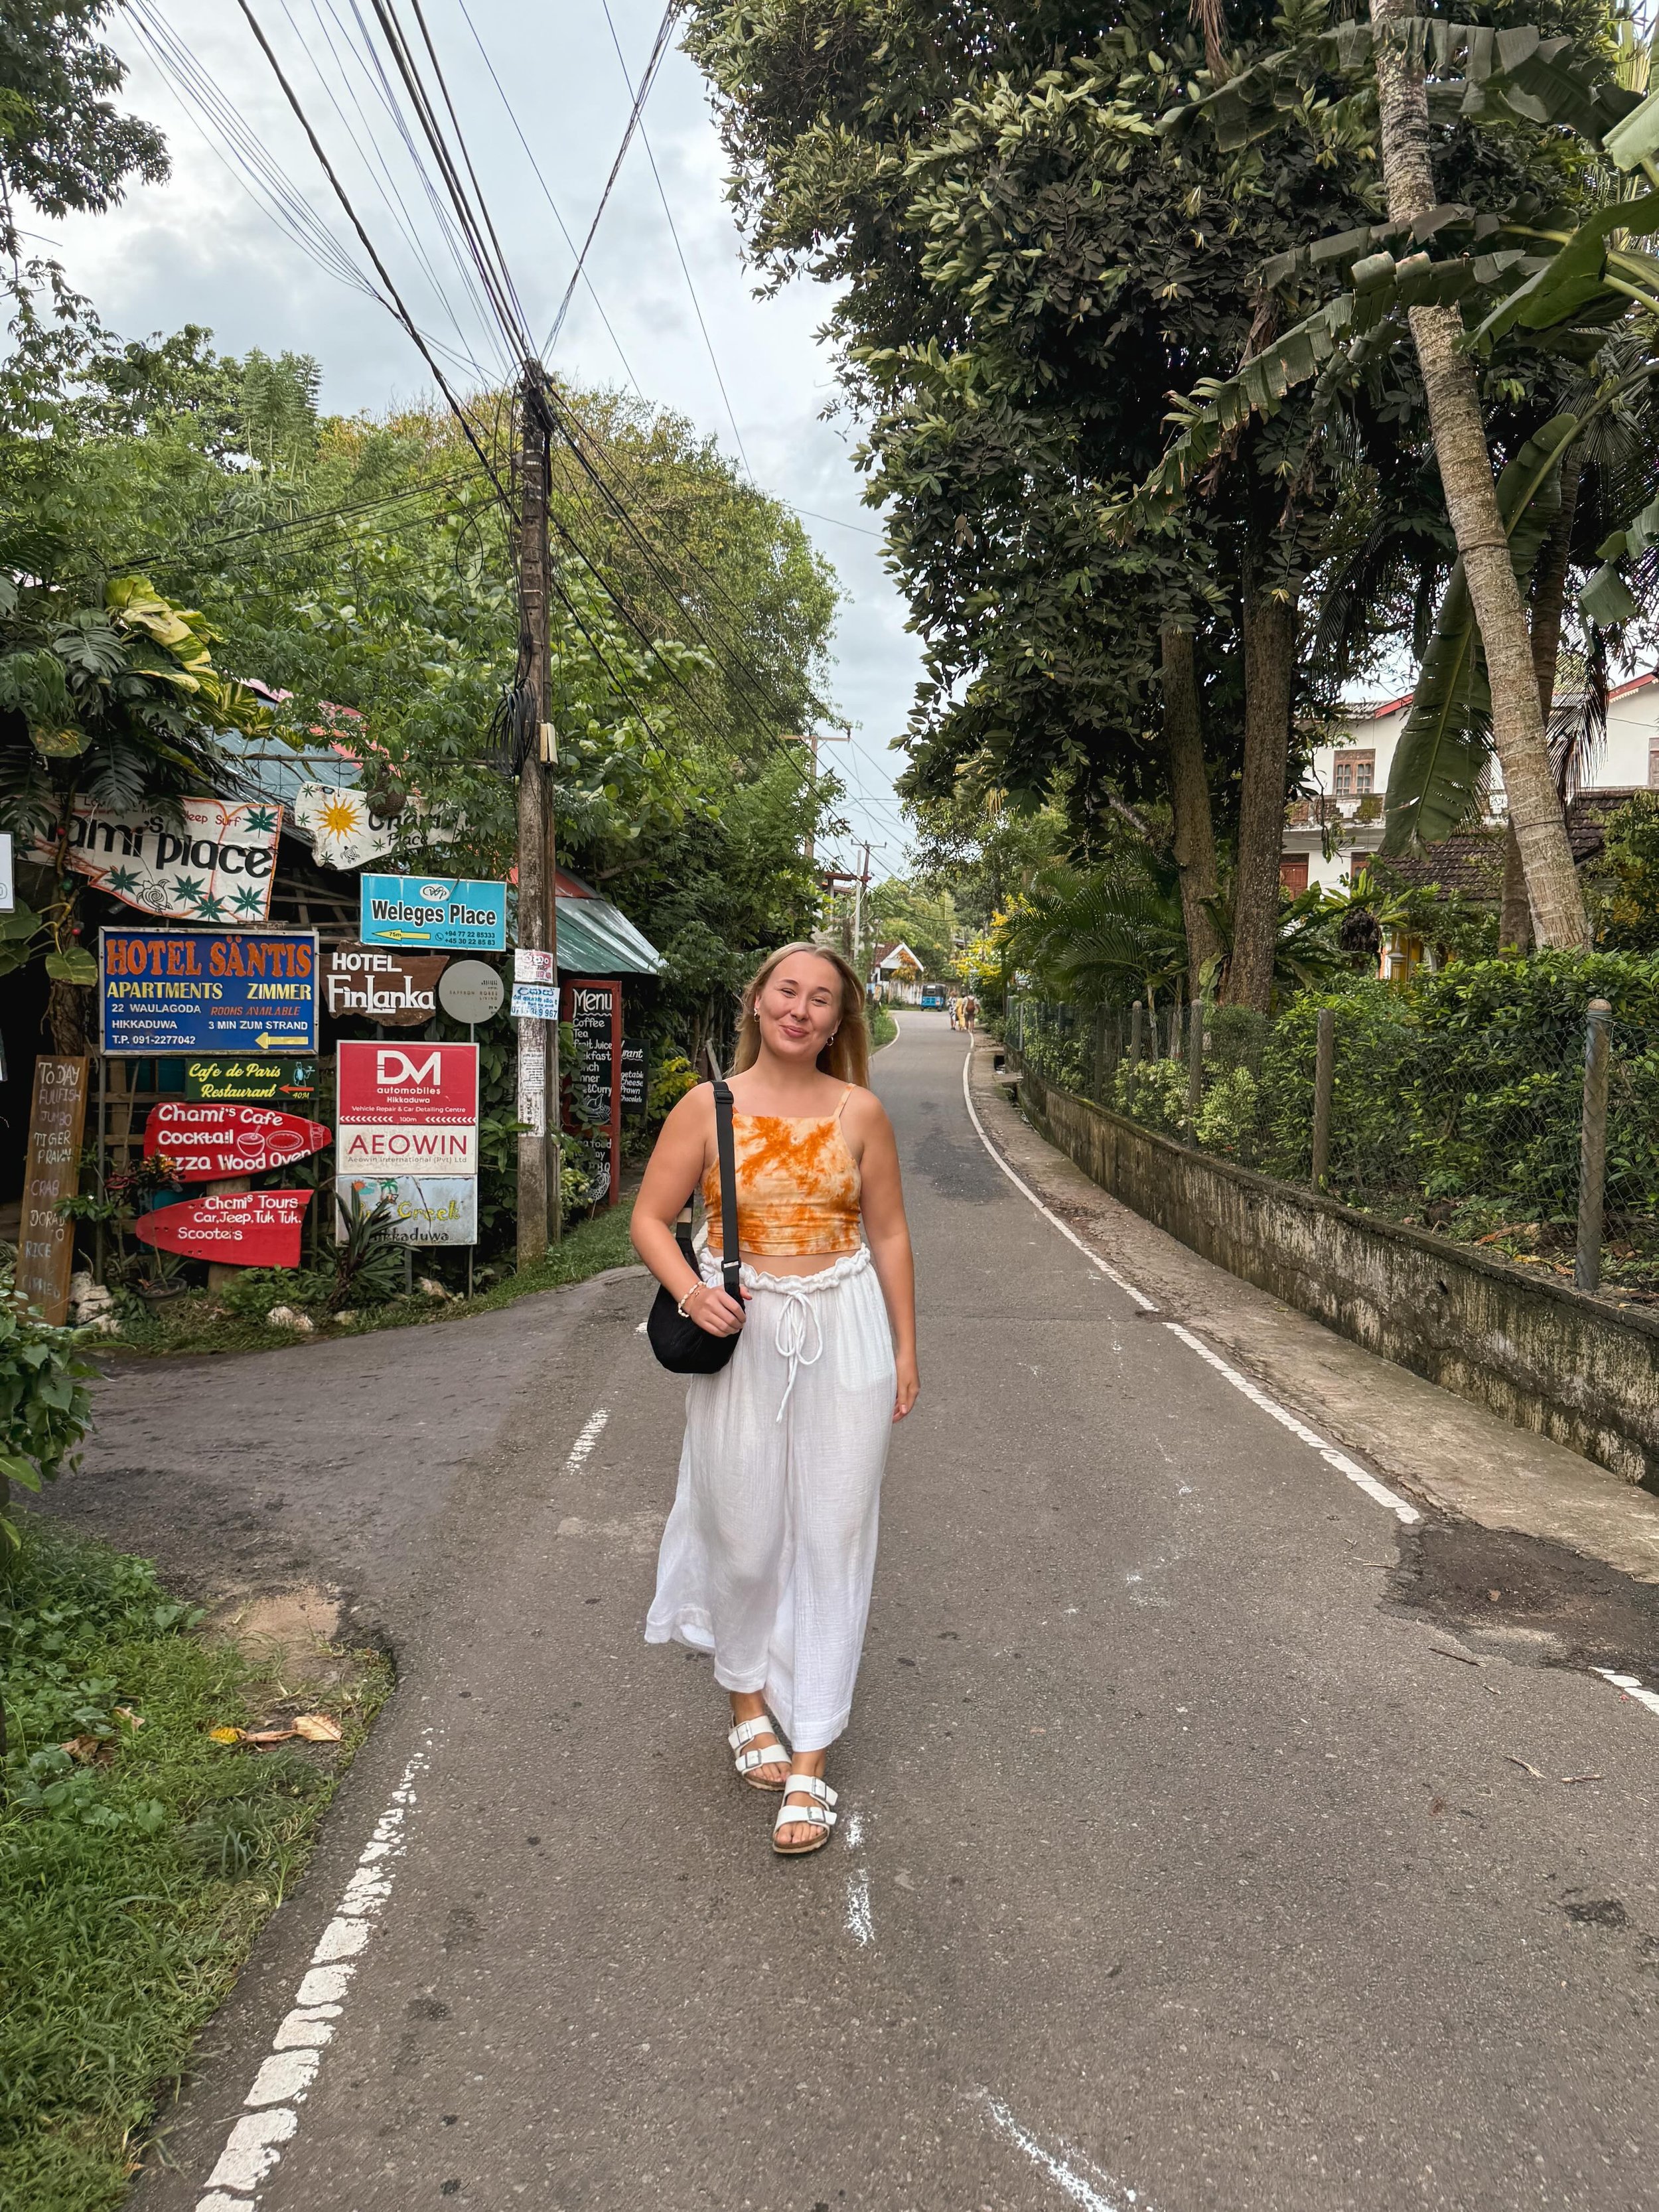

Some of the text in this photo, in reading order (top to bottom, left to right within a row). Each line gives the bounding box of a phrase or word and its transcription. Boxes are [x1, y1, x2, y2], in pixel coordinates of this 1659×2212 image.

[215, 814, 242, 827] Surf
[156, 832, 273, 879] place
[372, 899, 497, 927] Weleges Place
[106, 935, 312, 978] HOTEL SÄNTIS
[332, 952, 402, 972] HOTEL
[107, 982, 312, 1001] APARTMENTS ZIMMER
[111, 1003, 202, 1014] 22 WAULAGODA
[210, 1006, 301, 1016] ROOMS AVAILABLE
[572, 988, 613, 1018] Menu
[545, 1009, 558, 1018] 967
[573, 1017, 605, 1028] Coffee
[111, 1020, 178, 1029] HIKKADUWA
[208, 1021, 309, 1031] 3 MIN ZUM STRAND
[573, 1029, 589, 1038] Tea
[111, 1035, 196, 1045] T.P. 091-2277042
[594, 1039, 613, 1050] Juice
[188, 1063, 281, 1082] Cafe de Paris
[377, 1050, 441, 1086] DM
[201, 1083, 277, 1098] Restaurant
[159, 1104, 283, 1126] Chami's Cafe
[34, 1130, 71, 1147] TIGER
[348, 1134, 467, 1155] AEOWIN
[217, 1153, 265, 1171] Wood
[269, 1149, 312, 1168] Oven
[31, 1179, 60, 1197] CRAB
[257, 1195, 299, 1209] Tours
[397, 1200, 461, 1221] Creek
[25, 1240, 52, 1258] RICE
